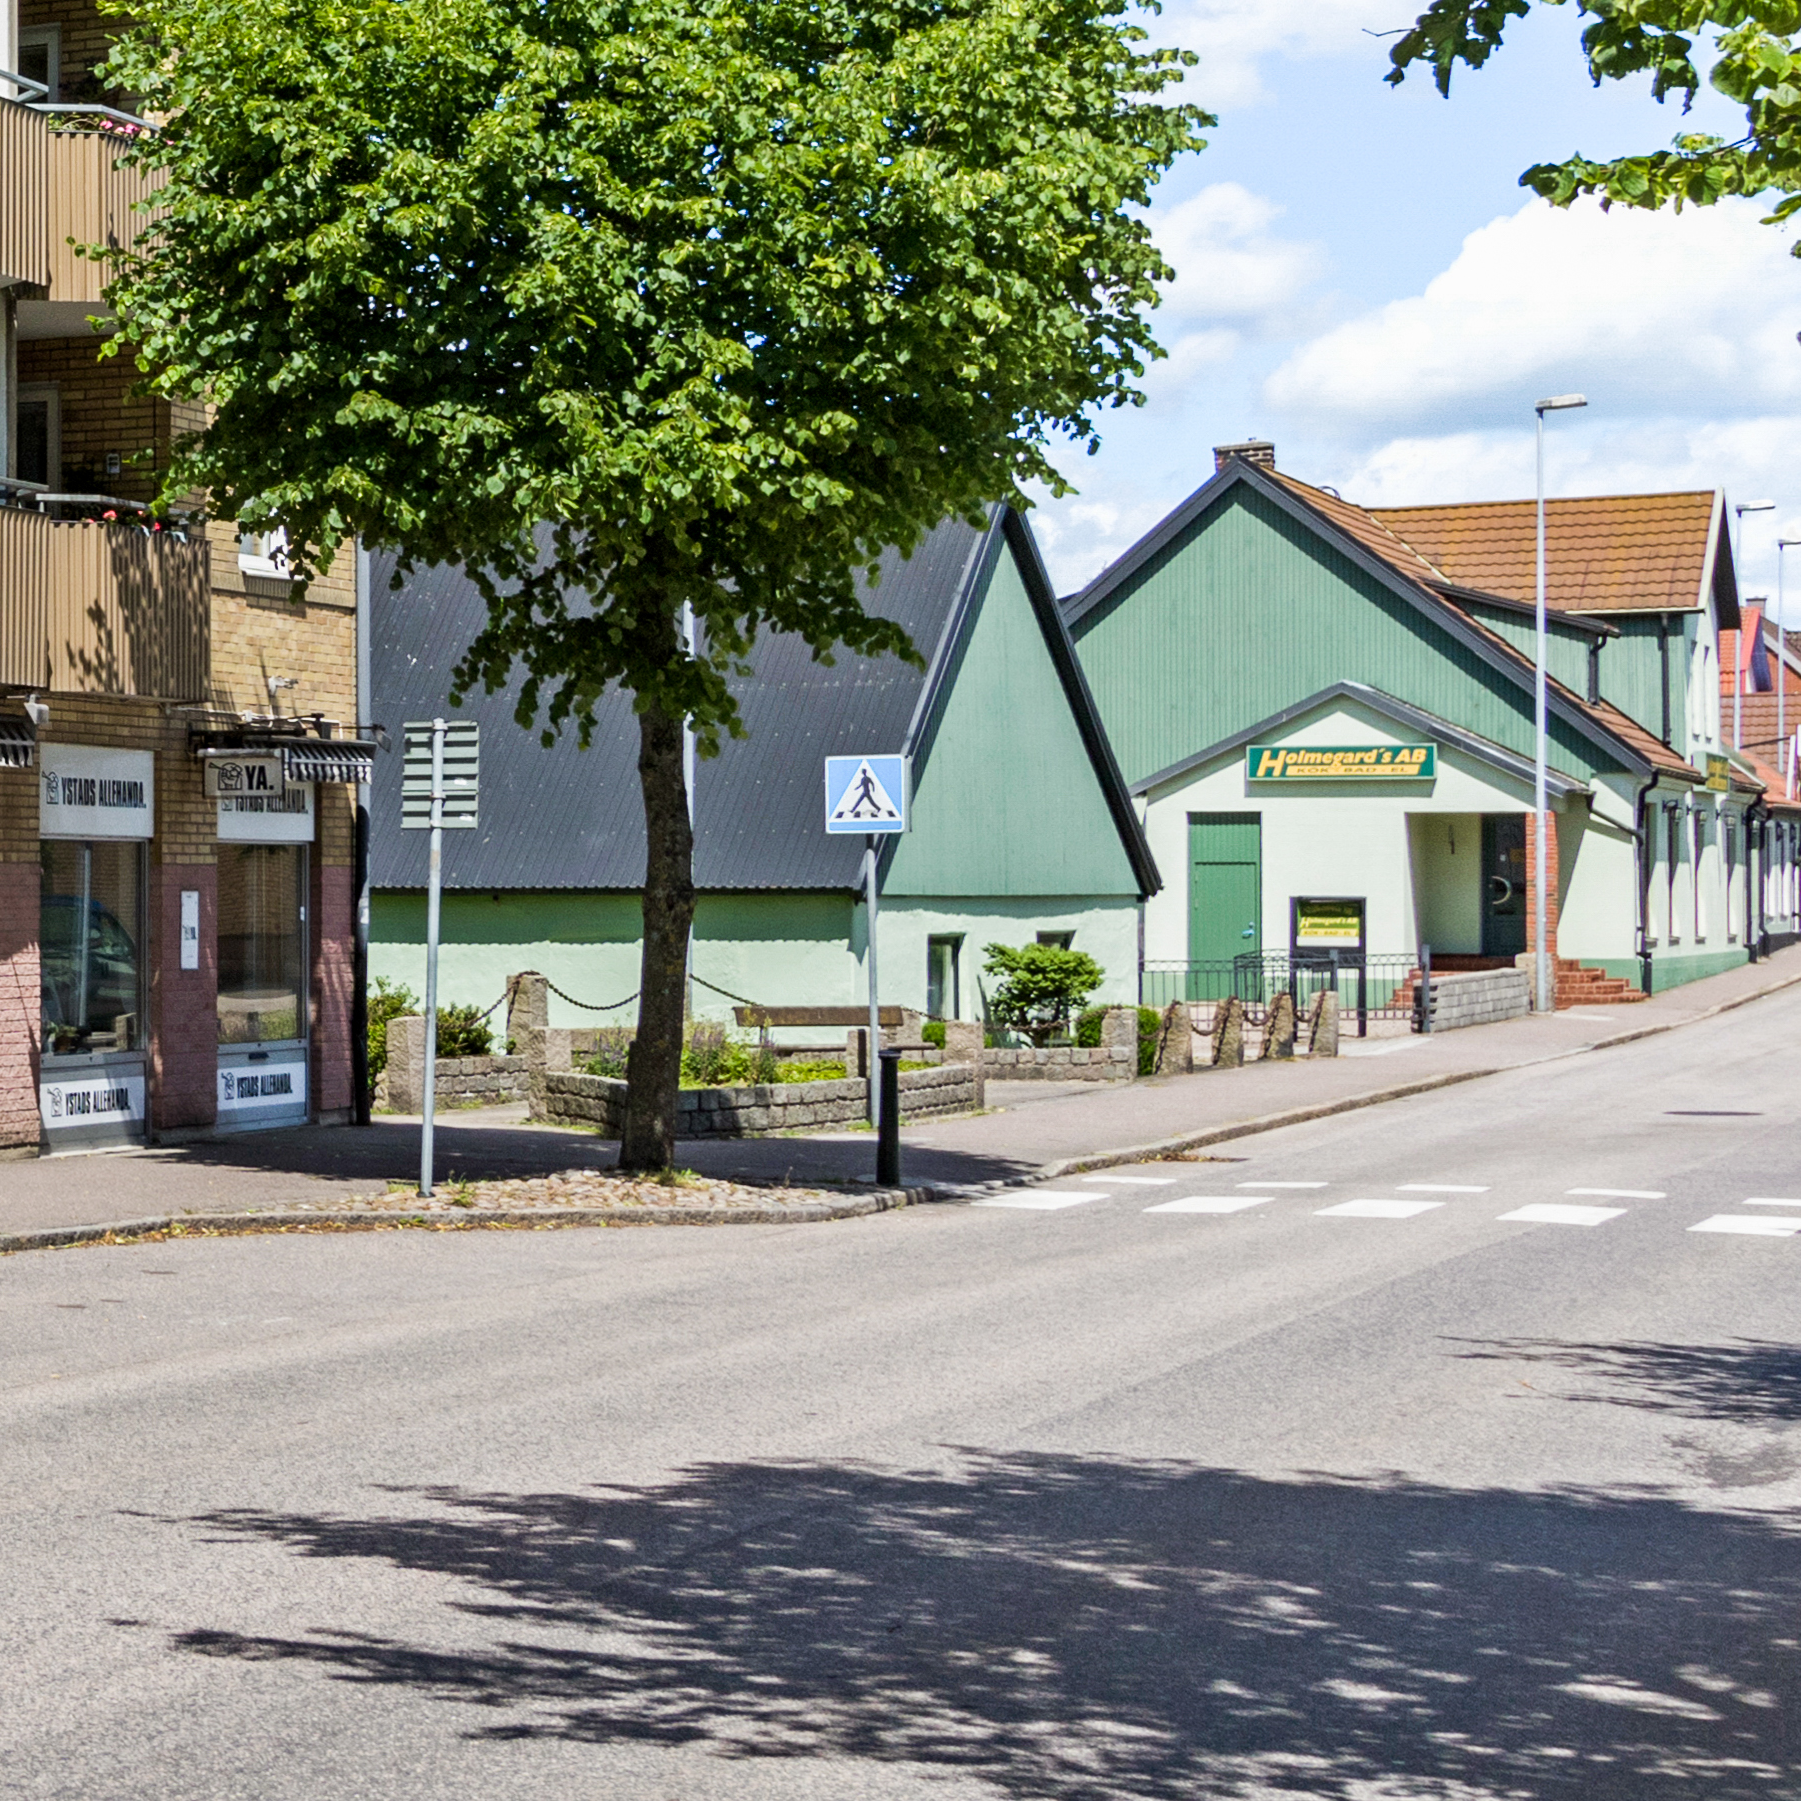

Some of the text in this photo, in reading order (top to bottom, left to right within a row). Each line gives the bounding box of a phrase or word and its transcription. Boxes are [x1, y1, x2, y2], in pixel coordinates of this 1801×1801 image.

[1394, 748, 1428, 764] AB
[61, 777, 147, 809] YSTADS ALLEHANDA.
[65, 1091, 91, 1116] YSTADS
